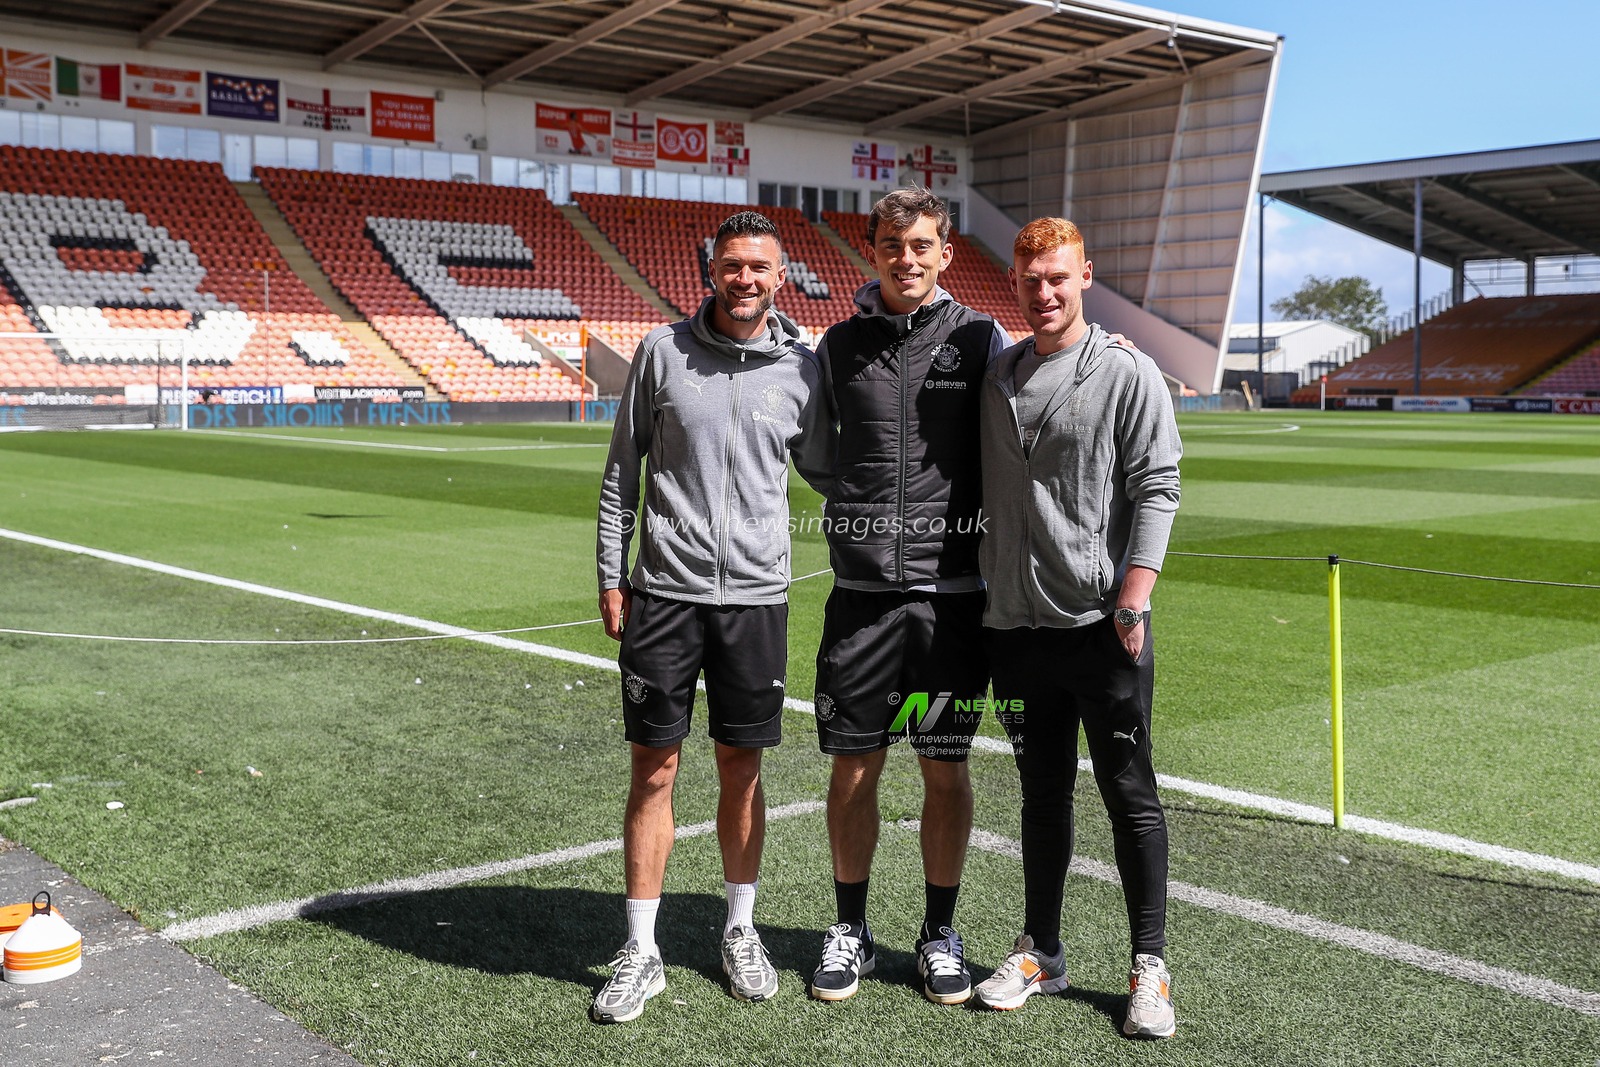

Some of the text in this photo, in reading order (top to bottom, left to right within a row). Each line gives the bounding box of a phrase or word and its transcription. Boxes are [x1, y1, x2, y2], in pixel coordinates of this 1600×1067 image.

[381, 100, 425, 111] YOU HAVE
[375, 109, 431, 122] OUR DREAMS
[375, 118, 432, 132] AT YOUR FEET
[263, 402, 343, 427] SHOWS
[367, 402, 451, 427] EVENTS
